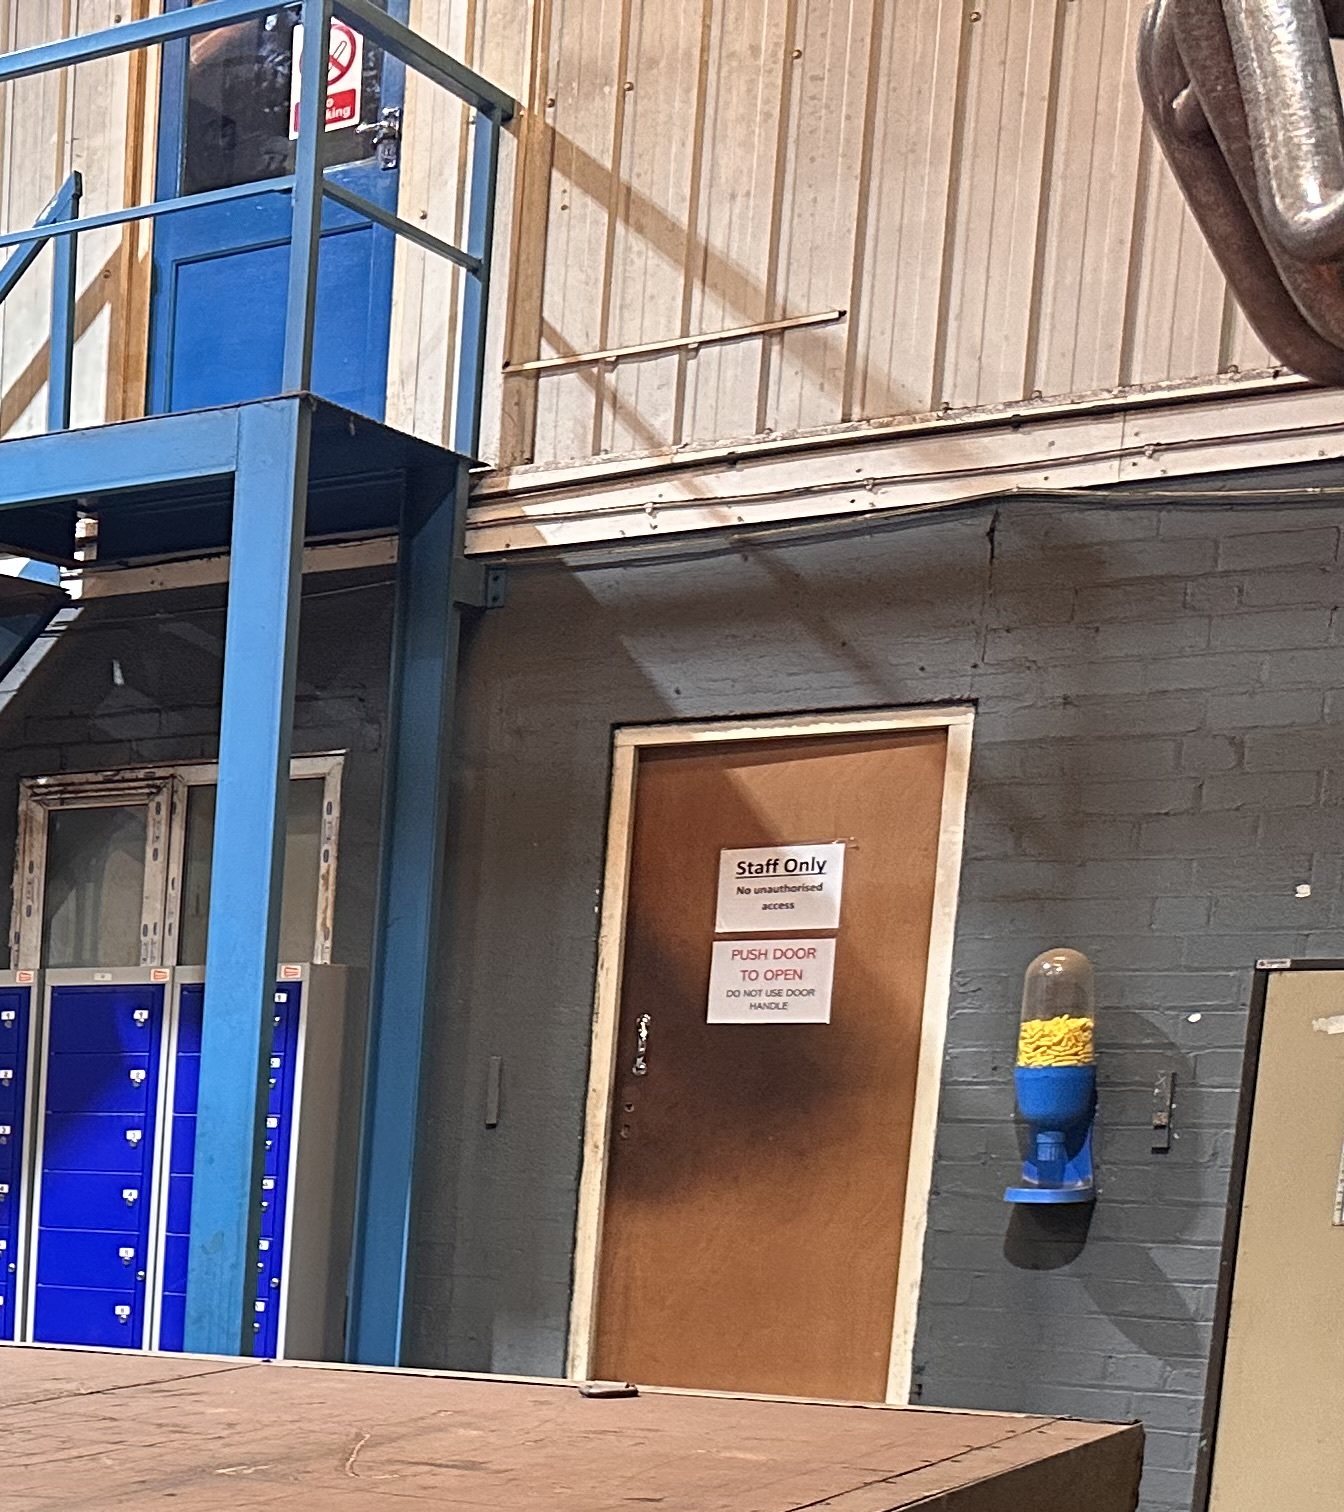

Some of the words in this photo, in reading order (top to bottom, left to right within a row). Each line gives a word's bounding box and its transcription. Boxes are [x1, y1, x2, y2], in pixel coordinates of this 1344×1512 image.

[326, 97, 334, 108] o
[326, 105, 351, 120] king
[736, 858, 780, 876] Staff
[784, 856, 827, 874] Only
[736, 886, 752, 895] No
[754, 882, 824, 895] unauthorised
[762, 902, 795, 911] access
[731, 949, 768, 960] PUSH
[773, 947, 817, 960] DOOR
[740, 969, 759, 981] TO
[763, 969, 803, 981] OPEN
[726, 989, 741, 998] DO
[743, 989, 763, 998] NOT
[765, 989, 783, 998] USE
[786, 988, 816, 998] DOOR
[749, 1001, 789, 1011] HANDLE
